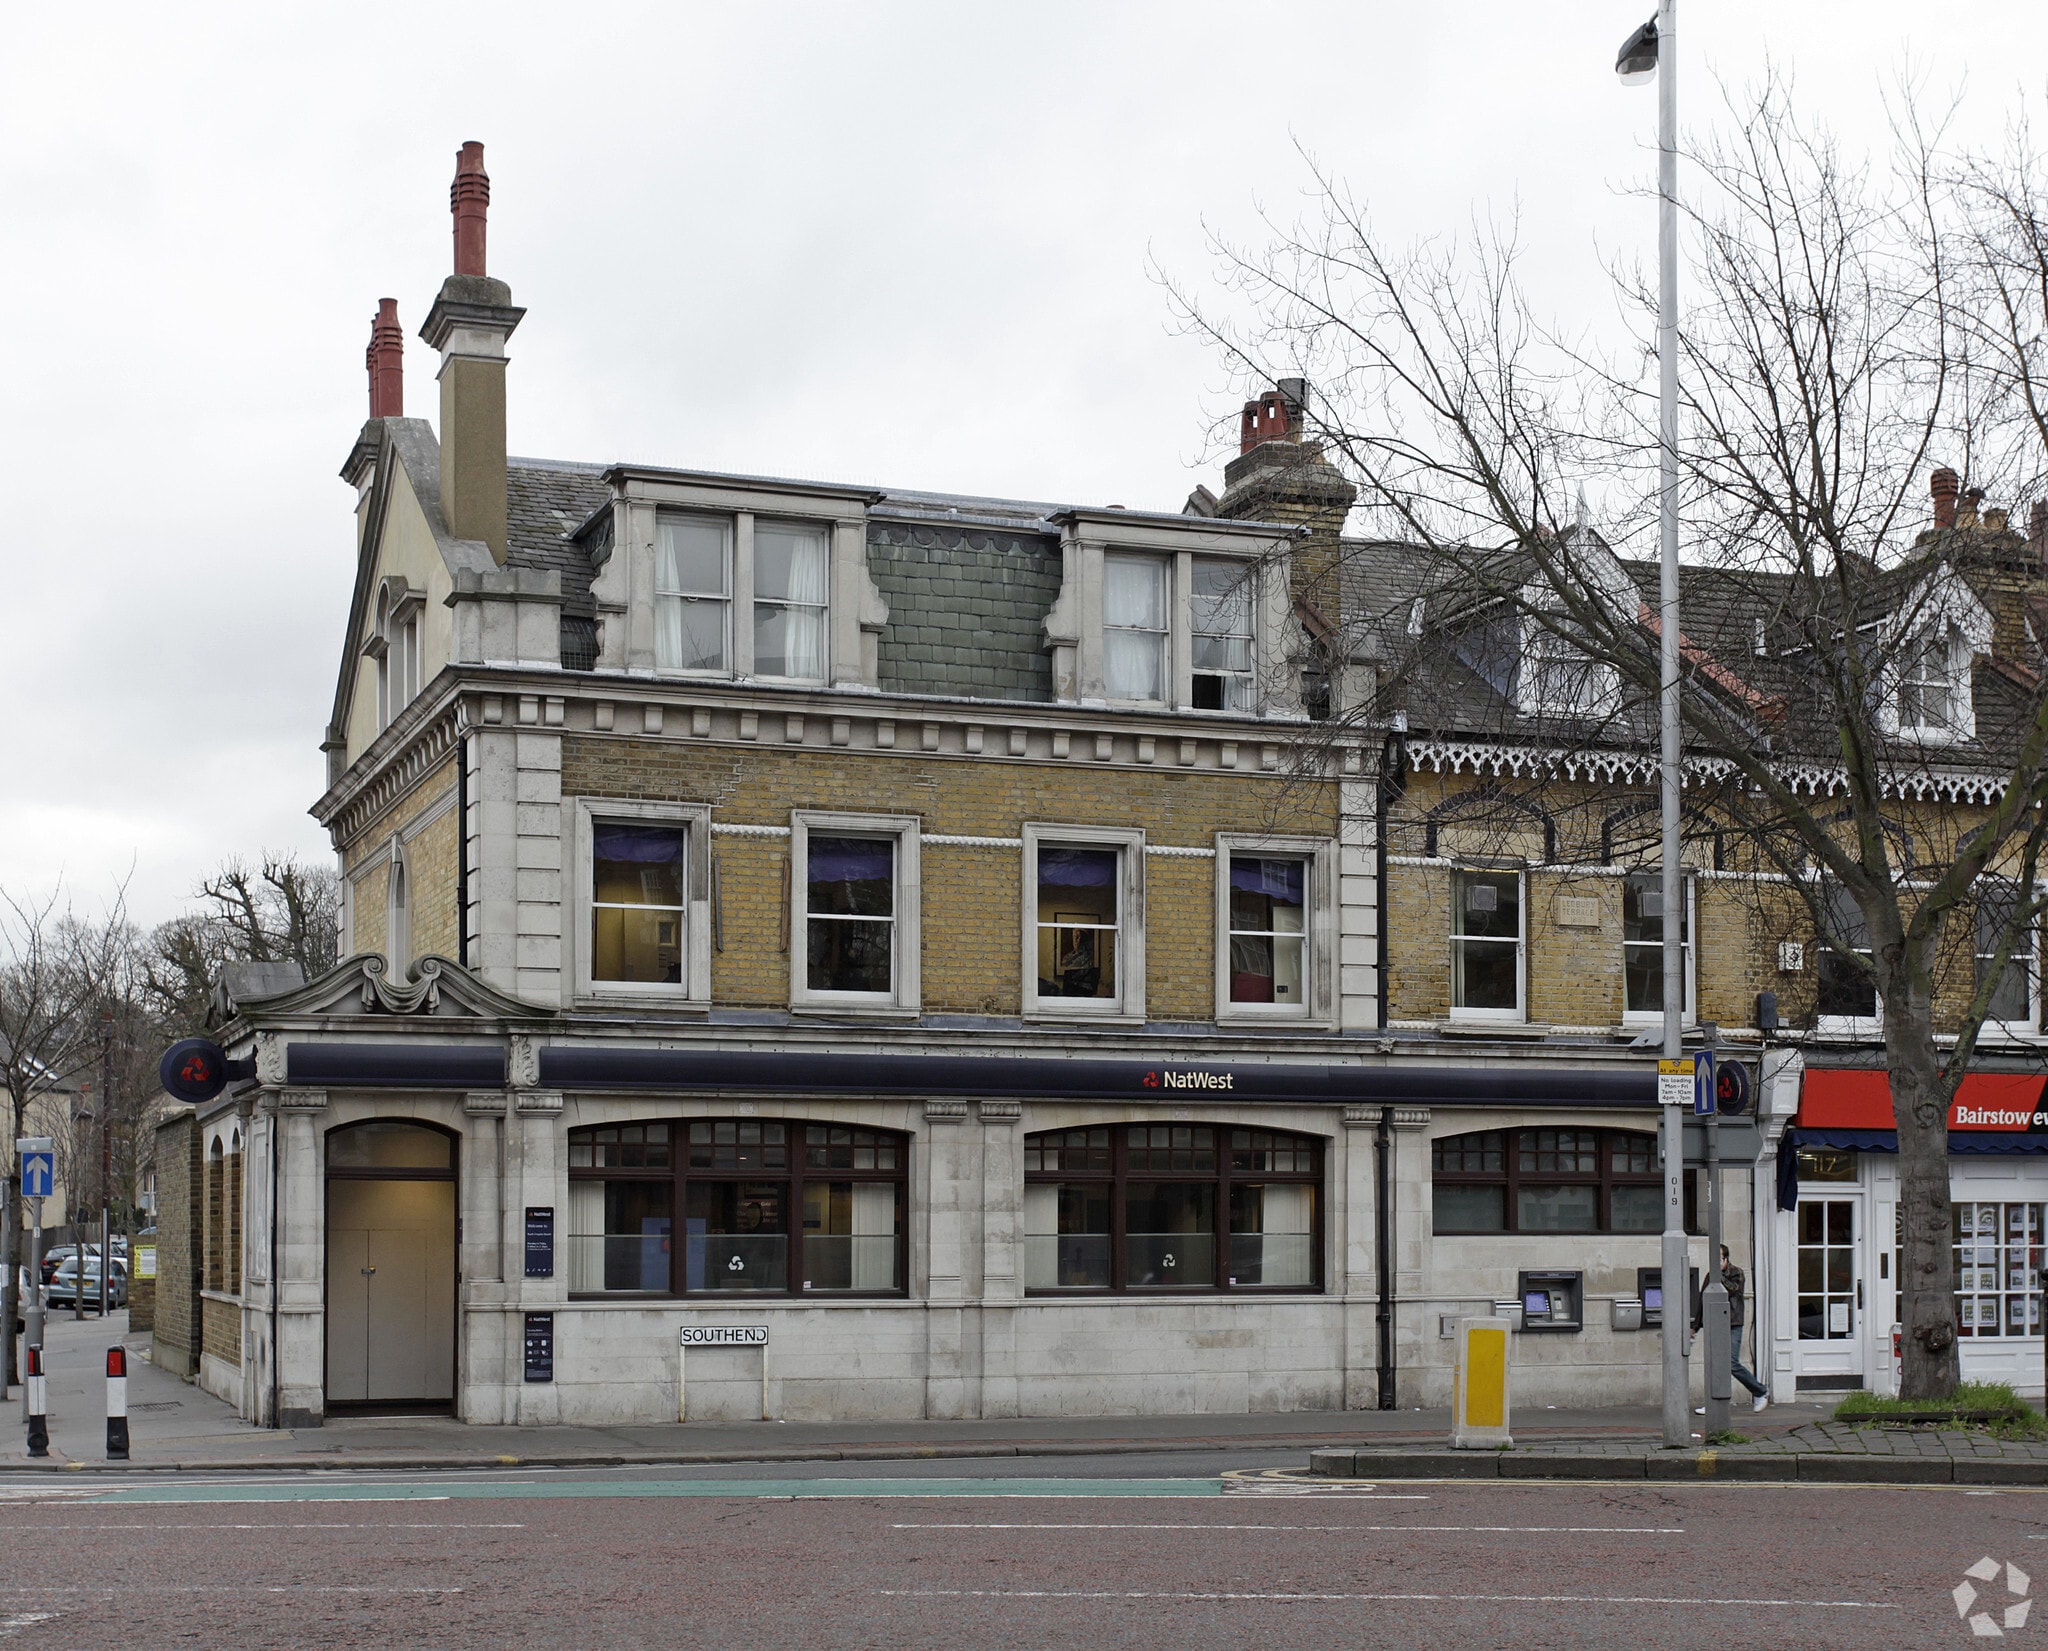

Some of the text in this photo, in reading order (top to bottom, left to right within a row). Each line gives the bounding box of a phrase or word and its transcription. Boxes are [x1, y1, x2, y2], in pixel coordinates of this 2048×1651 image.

[1164, 1071, 1234, 1089] NatWest
[1956, 1105, 2032, 1125] Bairstow
[682, 1329, 767, 1342] SOUTHEND
